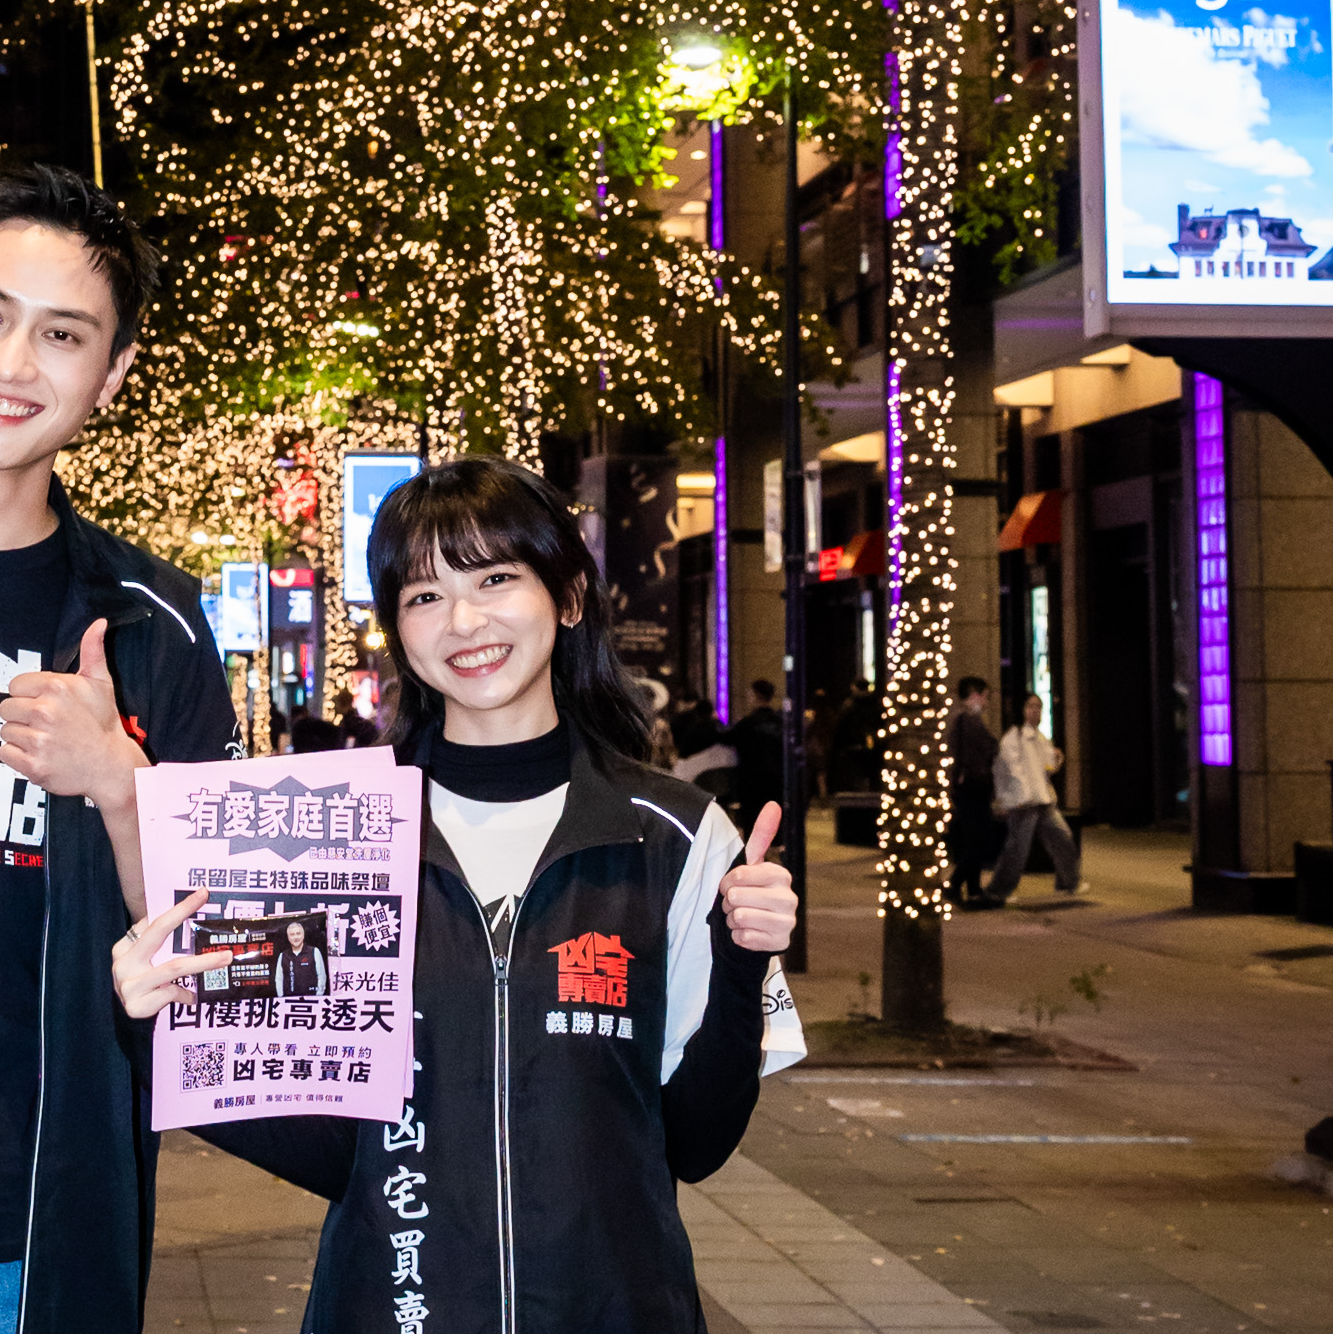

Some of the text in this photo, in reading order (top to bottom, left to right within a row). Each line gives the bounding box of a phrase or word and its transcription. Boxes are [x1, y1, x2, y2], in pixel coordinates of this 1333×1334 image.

[187, 787, 394, 842] 有愛家庭首選
[188, 868, 391, 893] 保留屋主特殊品味祭壇
[365, 924, 393, 945] 便宜
[547, 931, 635, 978] 凶宅
[333, 971, 399, 992] 採光佳
[558, 973, 628, 1007] 專賣店
[169, 998, 395, 1034] 四樓挑高透天
[546, 1010, 633, 1040] 義勝房屋
[234, 1042, 372, 1060] 專人帶看 立即預約
[233, 1058, 372, 1084] 凶宅專賣店
